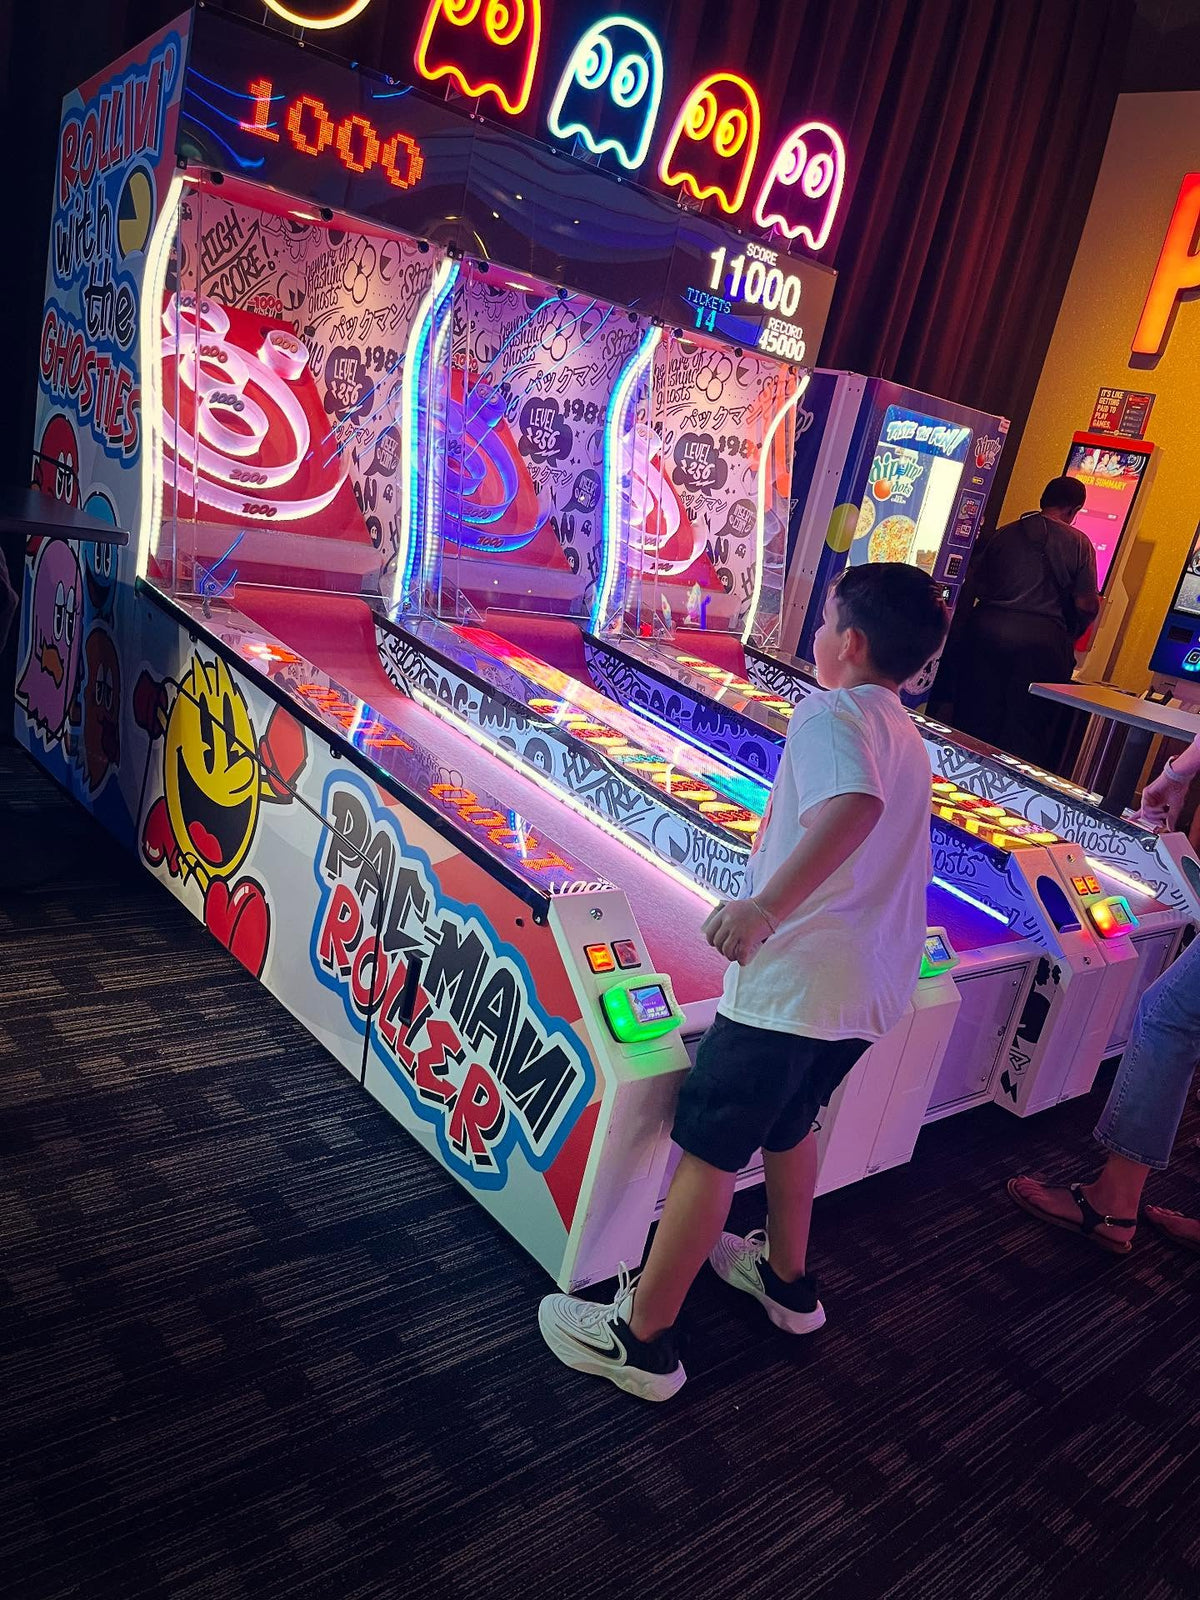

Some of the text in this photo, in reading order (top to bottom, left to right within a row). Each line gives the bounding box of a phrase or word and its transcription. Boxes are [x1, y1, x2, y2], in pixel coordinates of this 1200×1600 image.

[241, 79, 424, 190] 1000
[55, 178, 112, 278] with
[201, 207, 244, 275] HIGH
[747, 243, 779, 266] SCORE
[206, 235, 276, 305] SCORE!
[711, 246, 802, 318] 11000
[84, 260, 135, 348] the
[687, 287, 732, 314] TICKETS
[329, 304, 406, 343] パックマン
[694, 306, 718, 332] 14
[768, 317, 803, 339] RECORD
[758, 329, 806, 362] 45000
[40, 305, 142, 456] GHOSTIES
[333, 358, 360, 383] LEVEL
[1112, 390, 1124, 399] LIKE
[530, 408, 556, 433] LEVEL
[1093, 411, 1108, 420] PLAY
[684, 442, 711, 466] LEVEL
[229, 469, 268, 485] 2000
[241, 502, 278, 518] 1000
[325, 791, 578, 1143] PAC-MAN
[319, 884, 508, 1168] ROLLER
